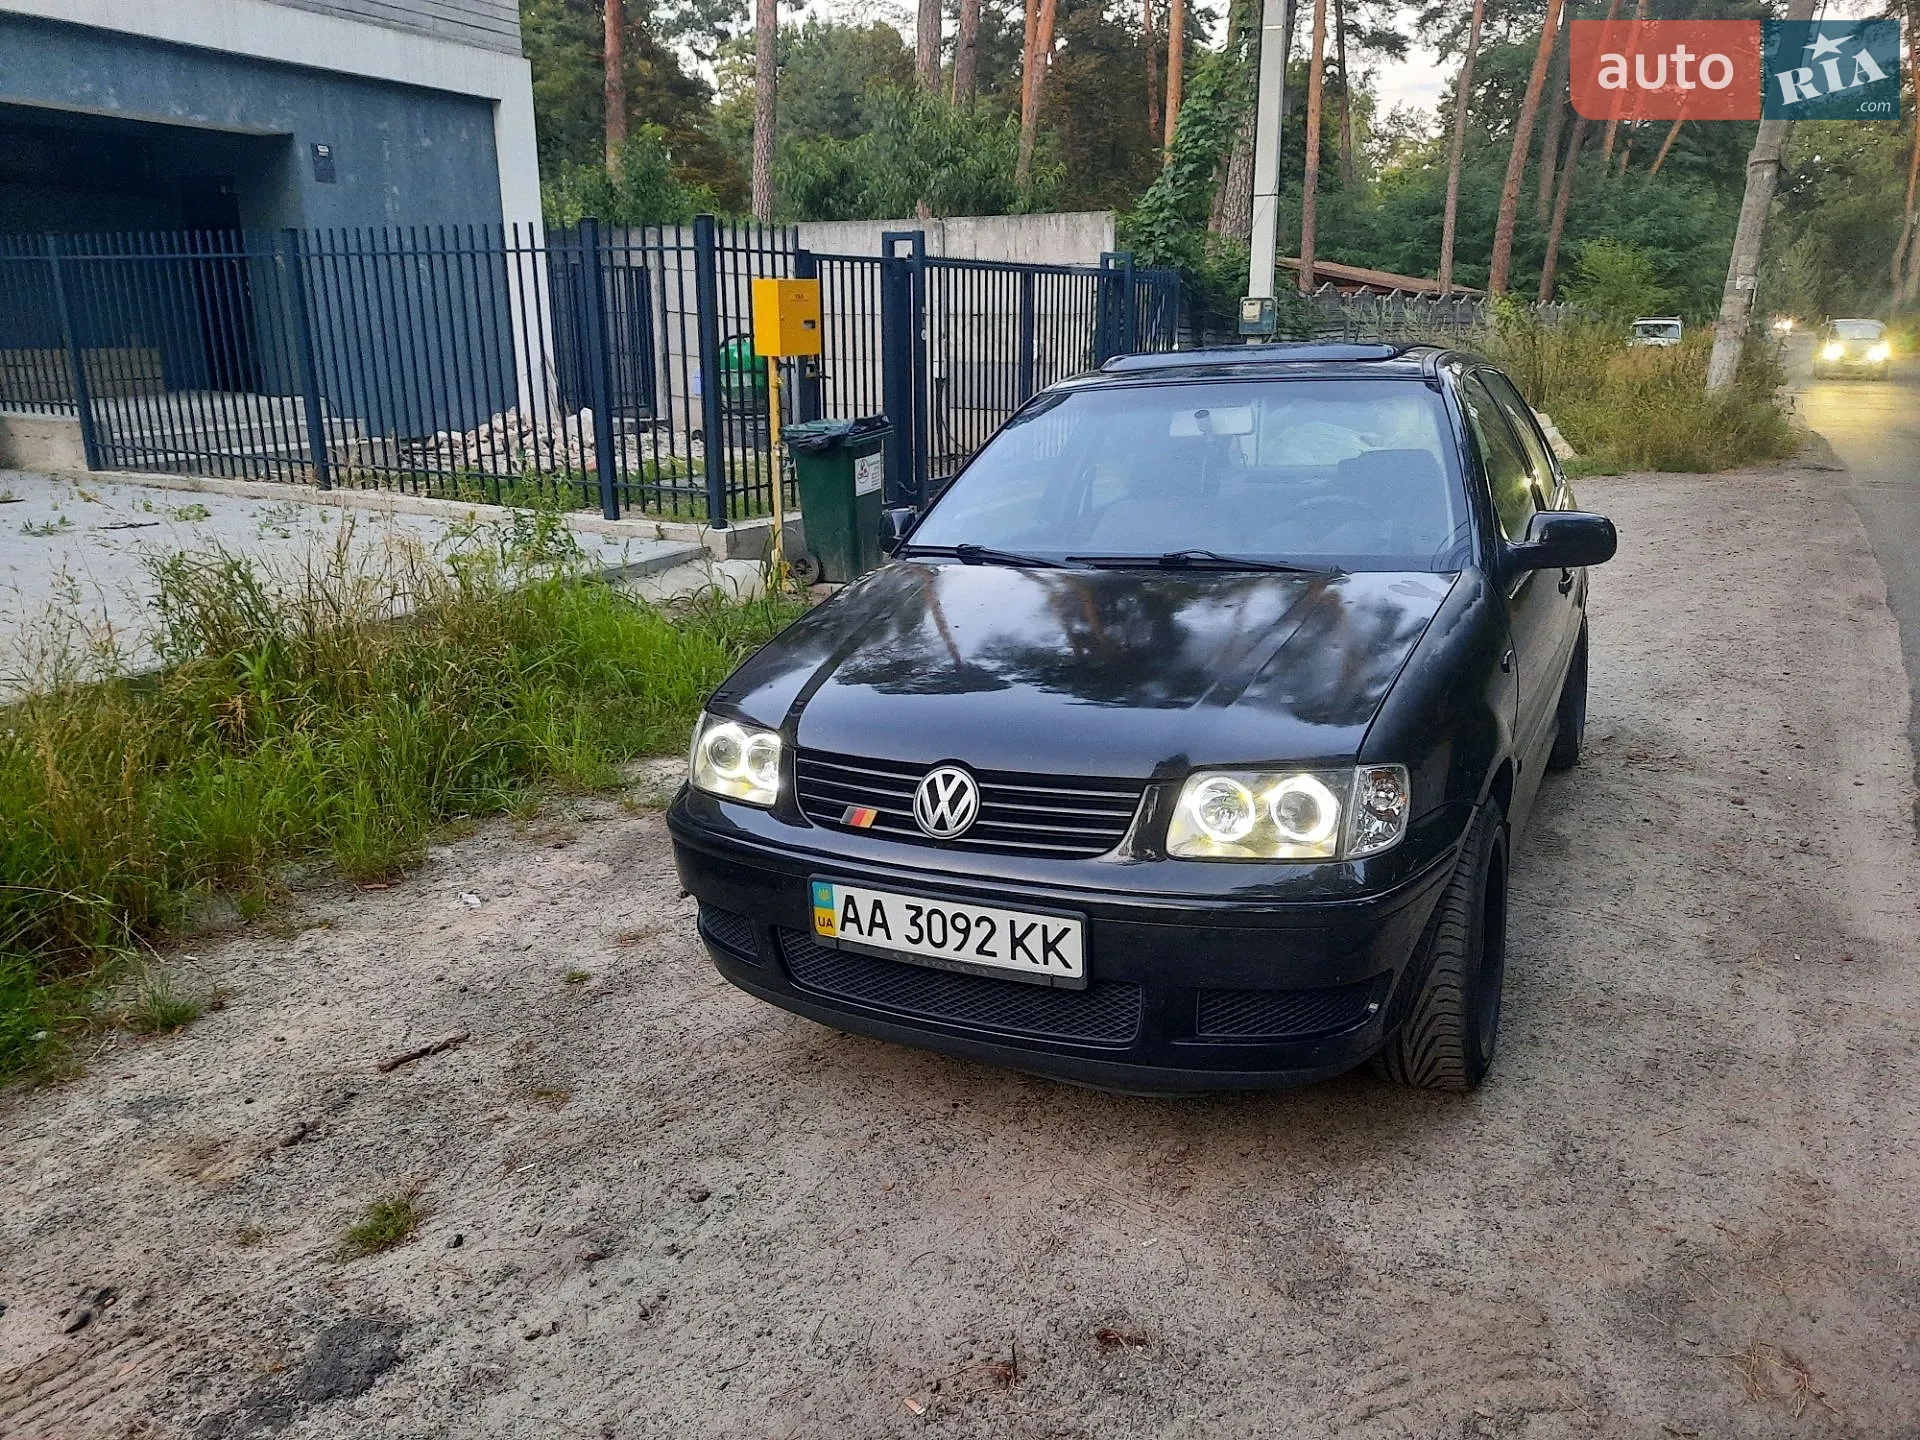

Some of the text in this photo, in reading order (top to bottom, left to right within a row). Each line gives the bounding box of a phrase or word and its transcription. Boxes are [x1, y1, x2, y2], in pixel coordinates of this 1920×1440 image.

[917, 770, 977, 835] VW
[818, 918, 834, 929] UA
[840, 895, 892, 940] AA
[905, 904, 997, 958] 3092
[1009, 920, 1072, 969] KK
